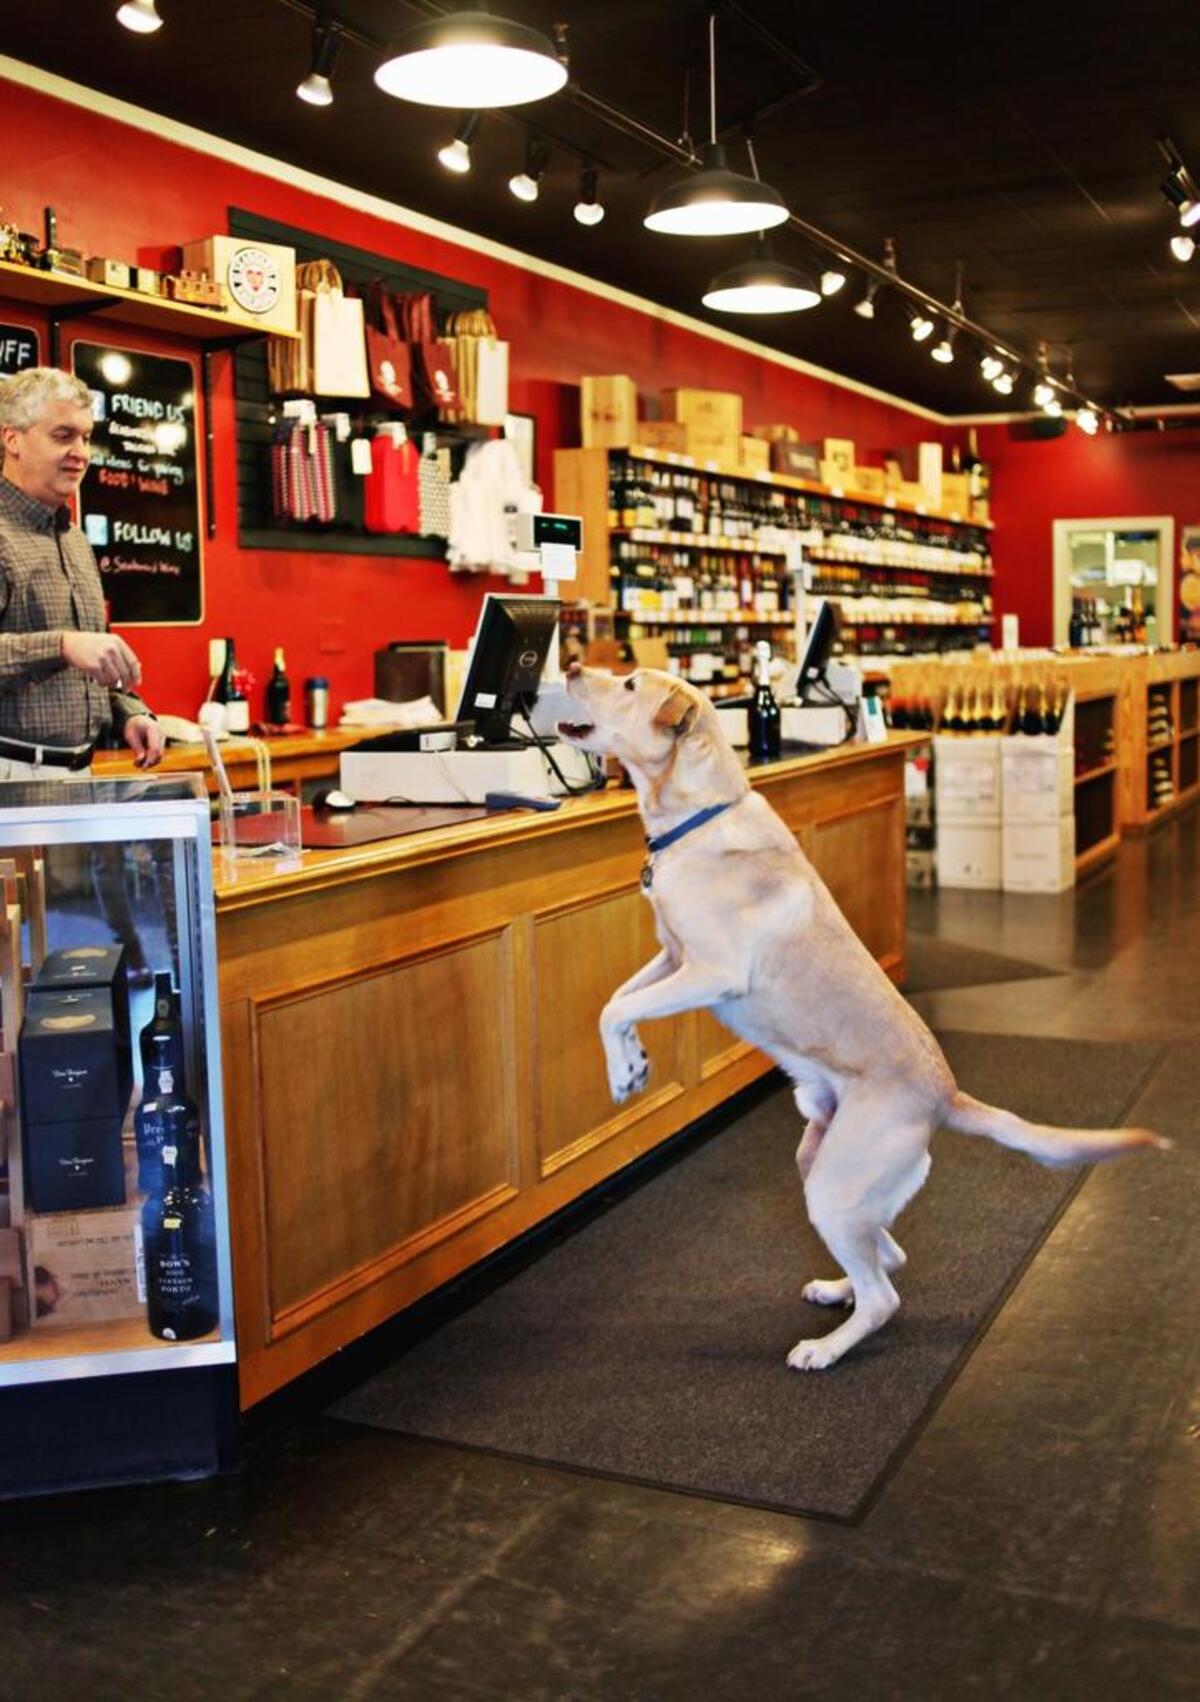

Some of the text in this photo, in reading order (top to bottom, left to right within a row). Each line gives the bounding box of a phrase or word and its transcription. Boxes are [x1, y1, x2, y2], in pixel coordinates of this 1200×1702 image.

[111, 394, 186, 424] FRIEND US
[113, 521, 193, 553] FOLLOW US
